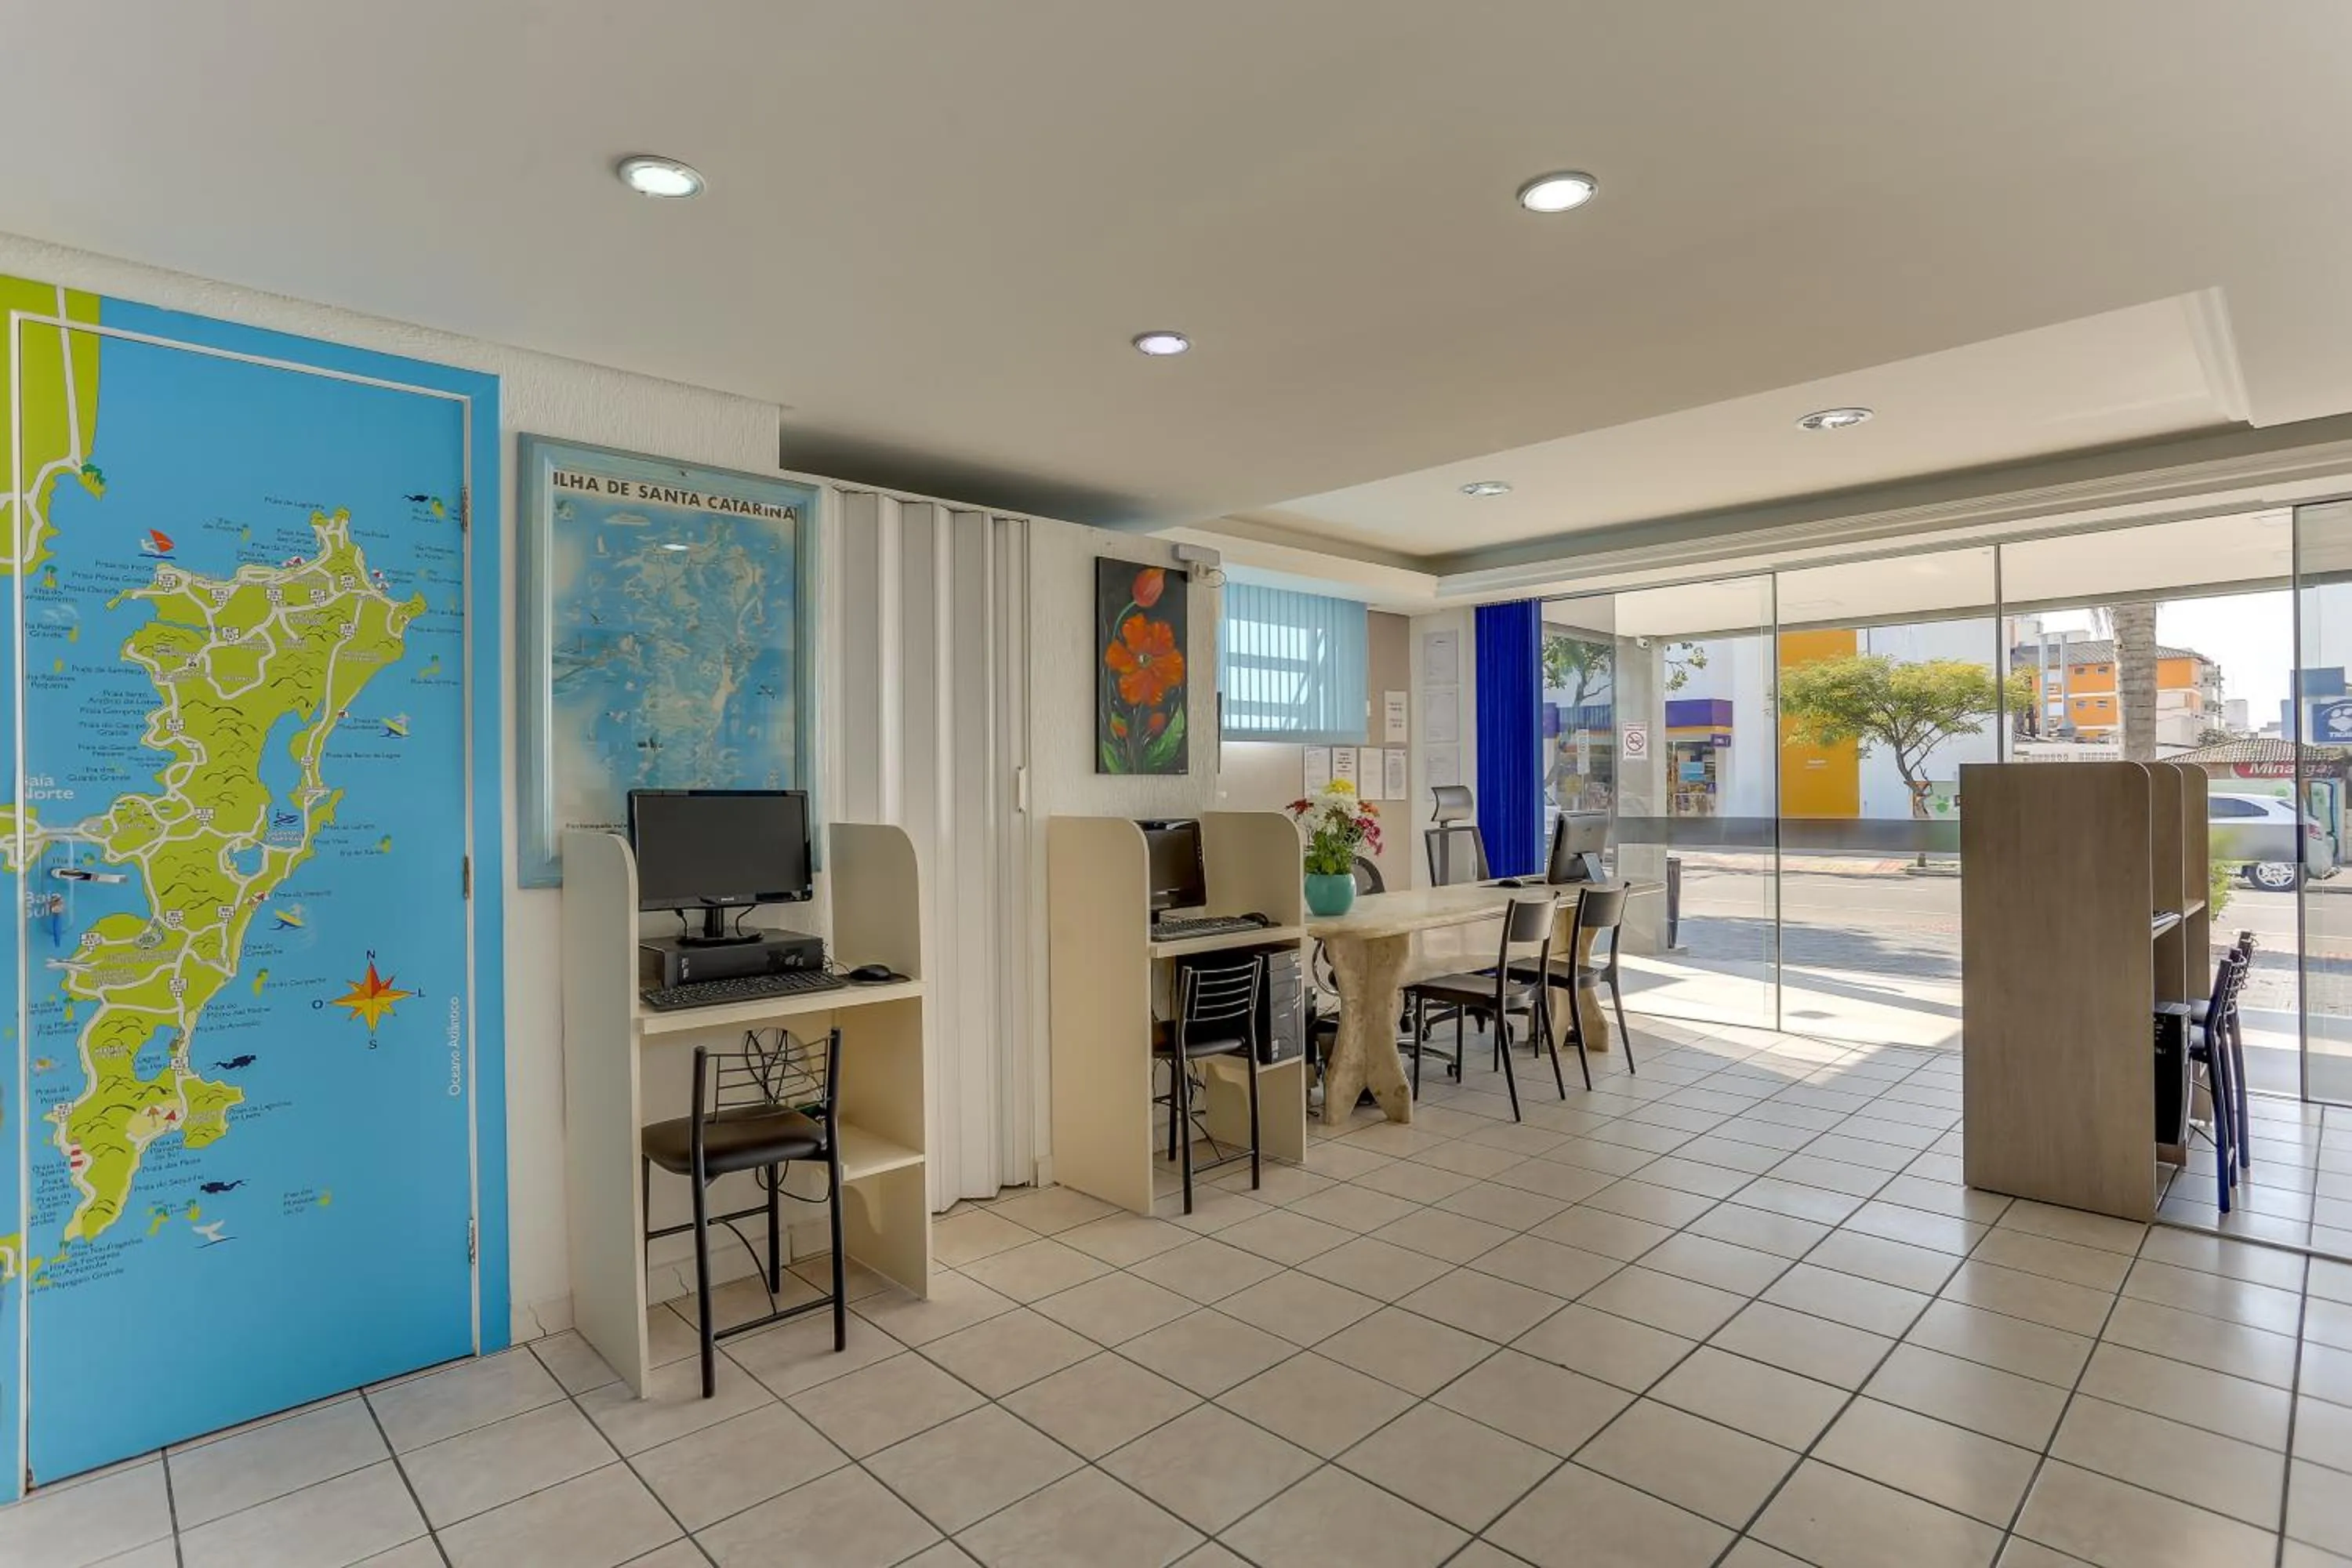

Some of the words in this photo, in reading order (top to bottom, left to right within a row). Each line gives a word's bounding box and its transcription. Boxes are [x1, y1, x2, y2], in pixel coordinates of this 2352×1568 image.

[554, 471, 599, 492] ILHA
[607, 480, 630, 495] DE
[639, 485, 700, 506] SANTA
[708, 495, 795, 521] CATARINA
[366, 950, 376, 960] N
[418, 989, 426, 998] L
[312, 1000, 323, 1010] O
[368, 1040, 377, 1050] S
